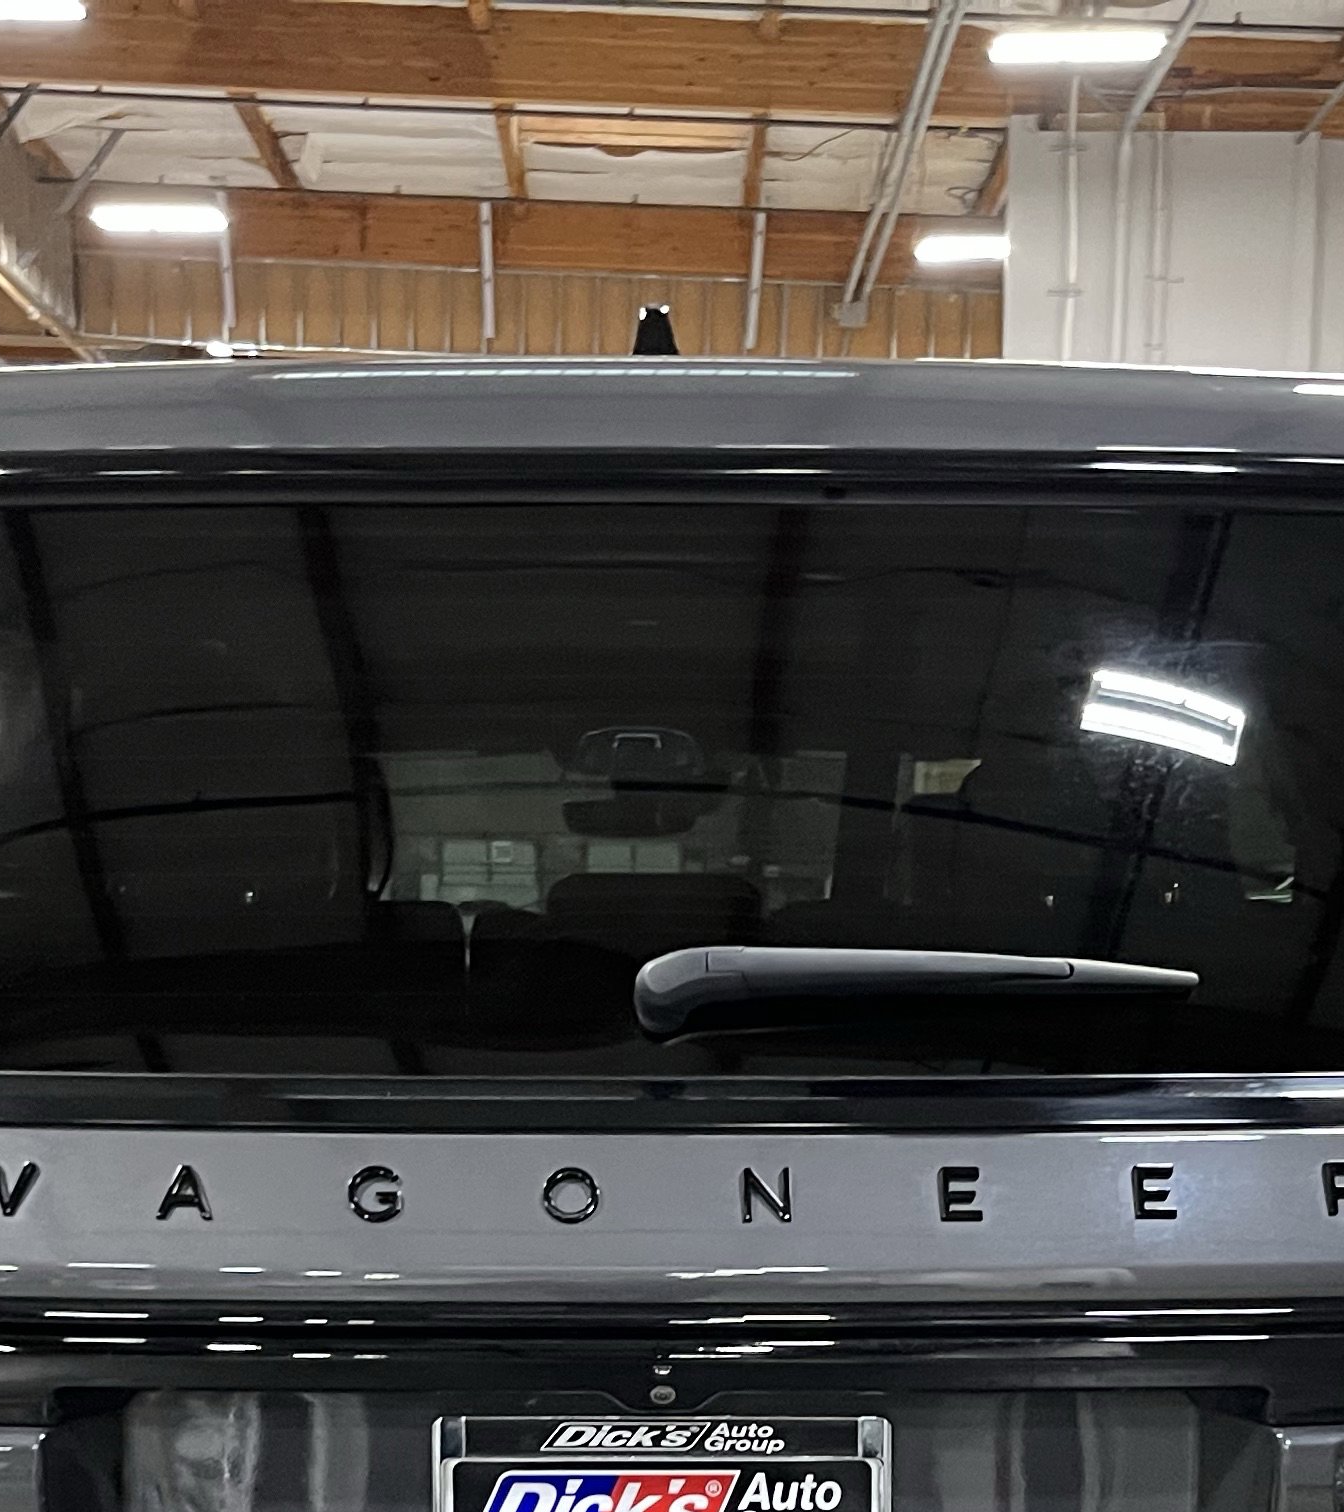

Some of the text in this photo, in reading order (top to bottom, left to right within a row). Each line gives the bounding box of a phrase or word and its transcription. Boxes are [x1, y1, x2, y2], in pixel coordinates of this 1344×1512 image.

[553, 1425, 693, 1447] Dick's
[709, 1422, 774, 1438] Auto
[704, 1437, 785, 1454] Group
[738, 1472, 842, 1511] Auto
